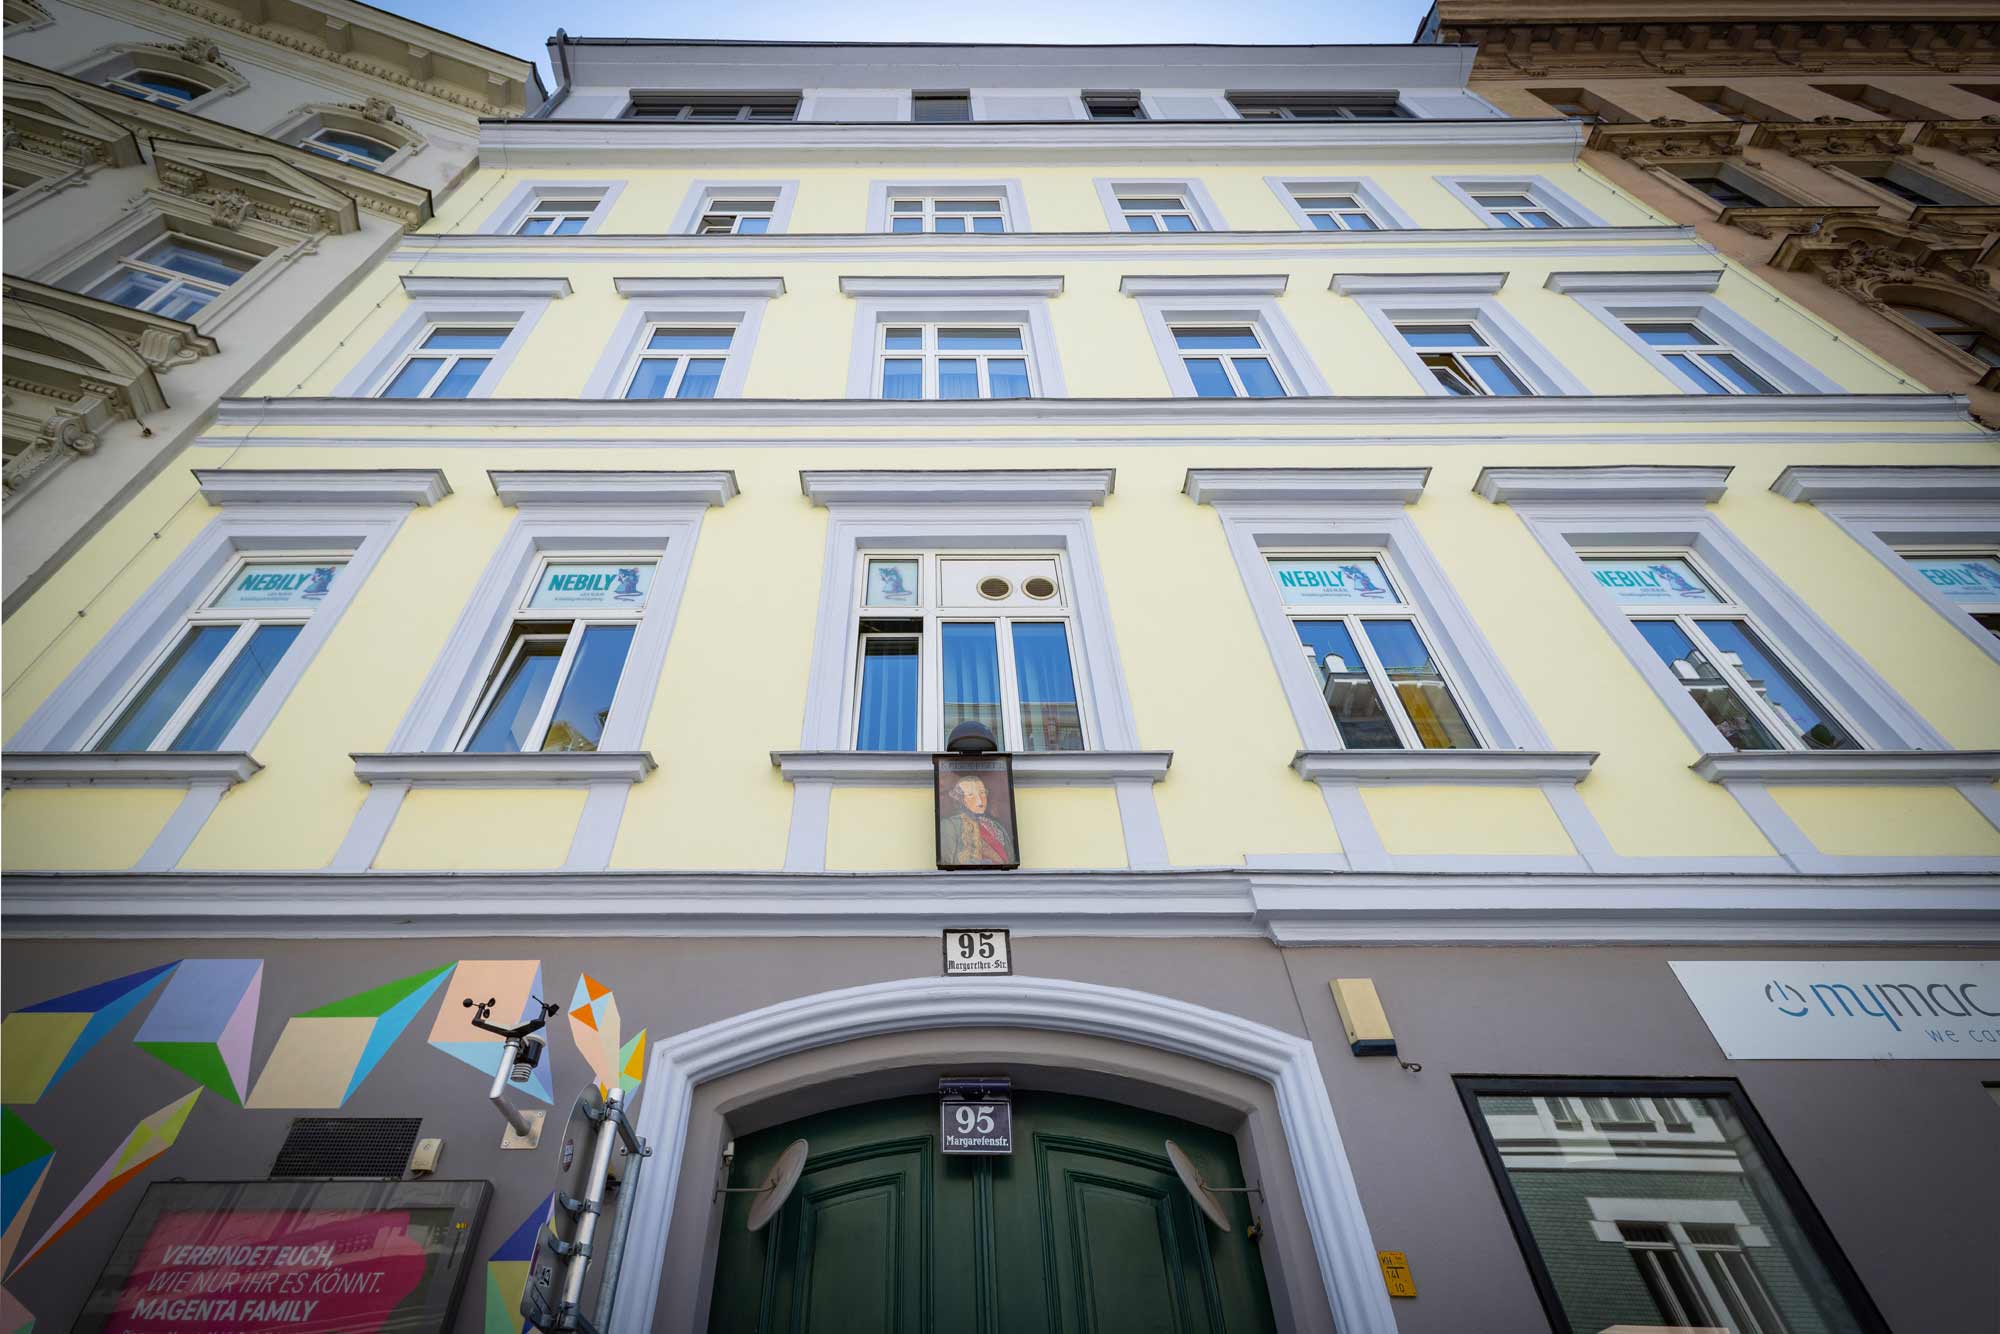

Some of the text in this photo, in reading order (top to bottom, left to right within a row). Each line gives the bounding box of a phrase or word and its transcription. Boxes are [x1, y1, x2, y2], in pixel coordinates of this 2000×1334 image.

[238, 573, 311, 591] NEBILY
[548, 574, 617, 591] NEBILY
[1280, 571, 1344, 587] NEBILY
[1592, 571, 1661, 587] NEBILY
[1919, 569, 1981, 585] EBILY
[958, 933, 995, 959] 95
[1809, 984, 2000, 1031] mymac
[1925, 1030, 1959, 1042] we
[955, 1106, 995, 1134] 95
[946, 1135, 1009, 1148] Margaretenstr.
[161, 1245, 337, 1268] VERBINDET EUCH,
[149, 1267, 385, 1293] WIE NUR IHR ES KÖNNT.
[130, 1300, 318, 1322] MAGENTA FAMILY
